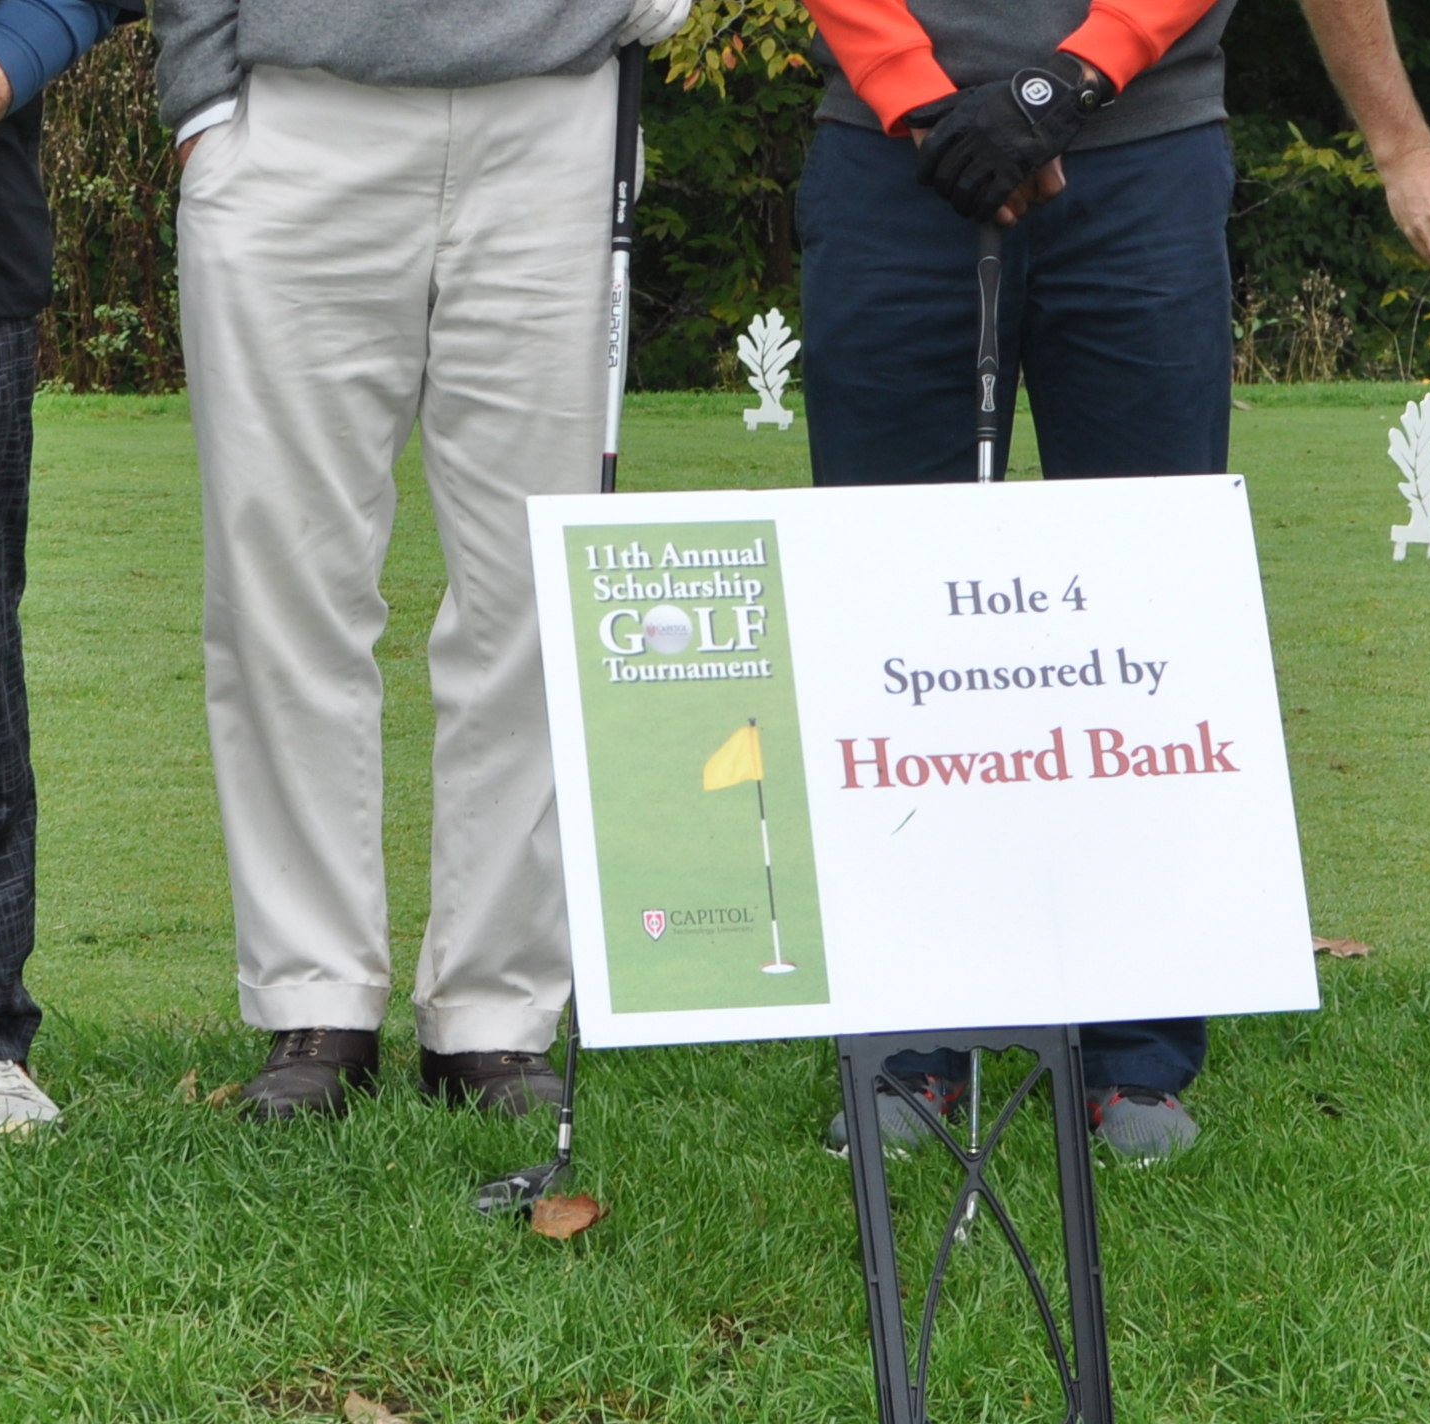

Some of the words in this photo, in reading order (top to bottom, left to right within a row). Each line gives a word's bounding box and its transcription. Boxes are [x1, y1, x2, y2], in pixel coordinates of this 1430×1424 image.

[608, 290, 622, 369] BURNER
[584, 541, 652, 571] 11th
[659, 537, 767, 569] Annual
[592, 570, 764, 605] Scholarship
[945, 577, 1049, 616] Hole
[1061, 575, 1088, 612] 4
[598, 604, 768, 656] GOLF
[602, 657, 773, 683] Tournament
[882, 648, 1106, 706] Sponsored
[1116, 647, 1169, 695] by
[836, 726, 1073, 790] Howard
[1084, 720, 1241, 780] Bank
[670, 907, 754, 926] CAPITOL
